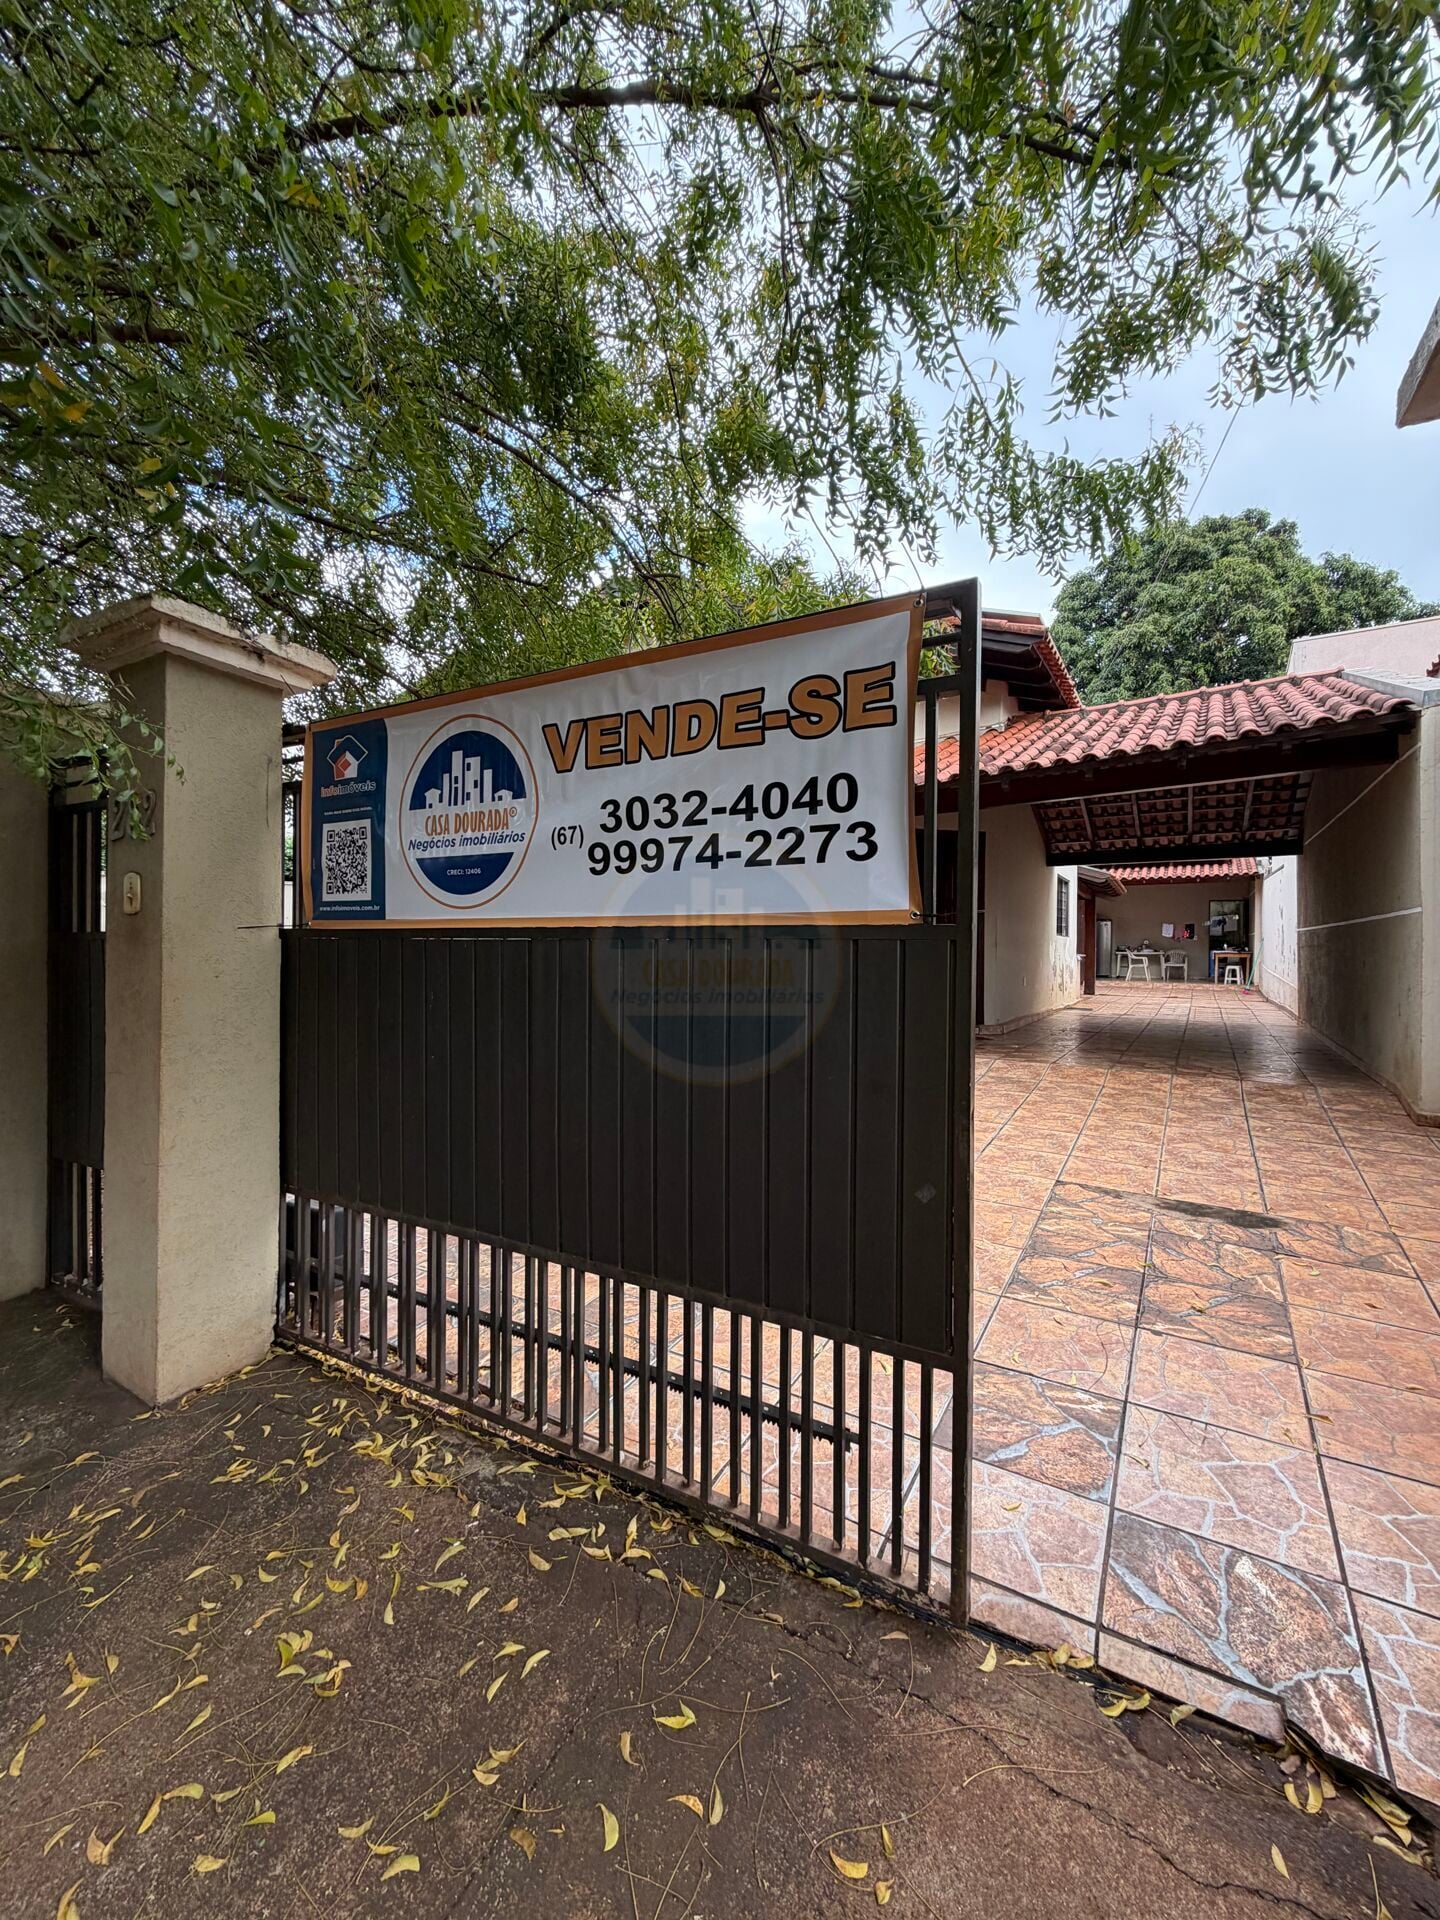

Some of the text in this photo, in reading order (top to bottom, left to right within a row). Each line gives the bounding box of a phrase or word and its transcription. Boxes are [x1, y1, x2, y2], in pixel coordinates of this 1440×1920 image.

[543, 661, 896, 773] VENDE-SE
[321, 780, 376, 797] infoimóveis
[599, 772, 859, 834] 3032-4040
[408, 830, 526, 852] Negócios imobiliários
[425, 812, 450, 837] CASA
[551, 821, 879, 876] (67) 99974-2273
